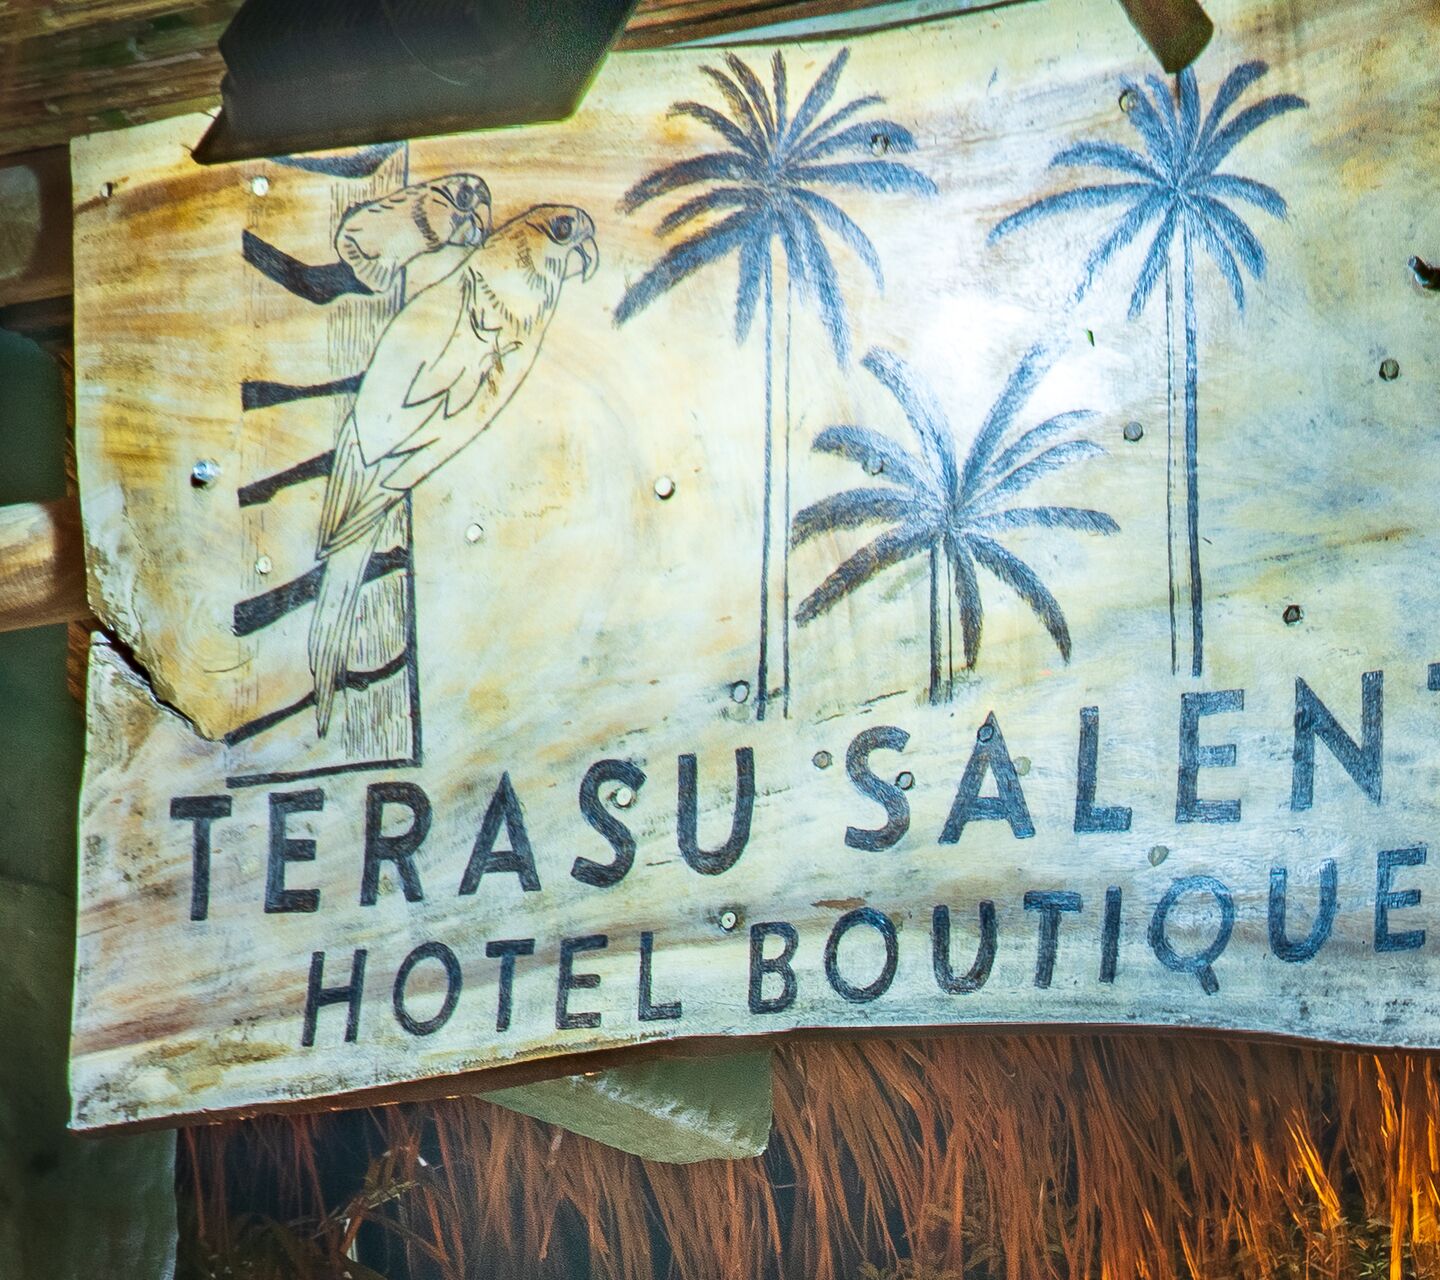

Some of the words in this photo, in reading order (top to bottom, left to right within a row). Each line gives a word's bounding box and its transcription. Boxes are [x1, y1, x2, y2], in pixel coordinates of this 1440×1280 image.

[170, 747, 755, 921] TERASU
[301, 931, 683, 1047] HOTEL
[748, 846, 1427, 1014] BOUTIQUE
